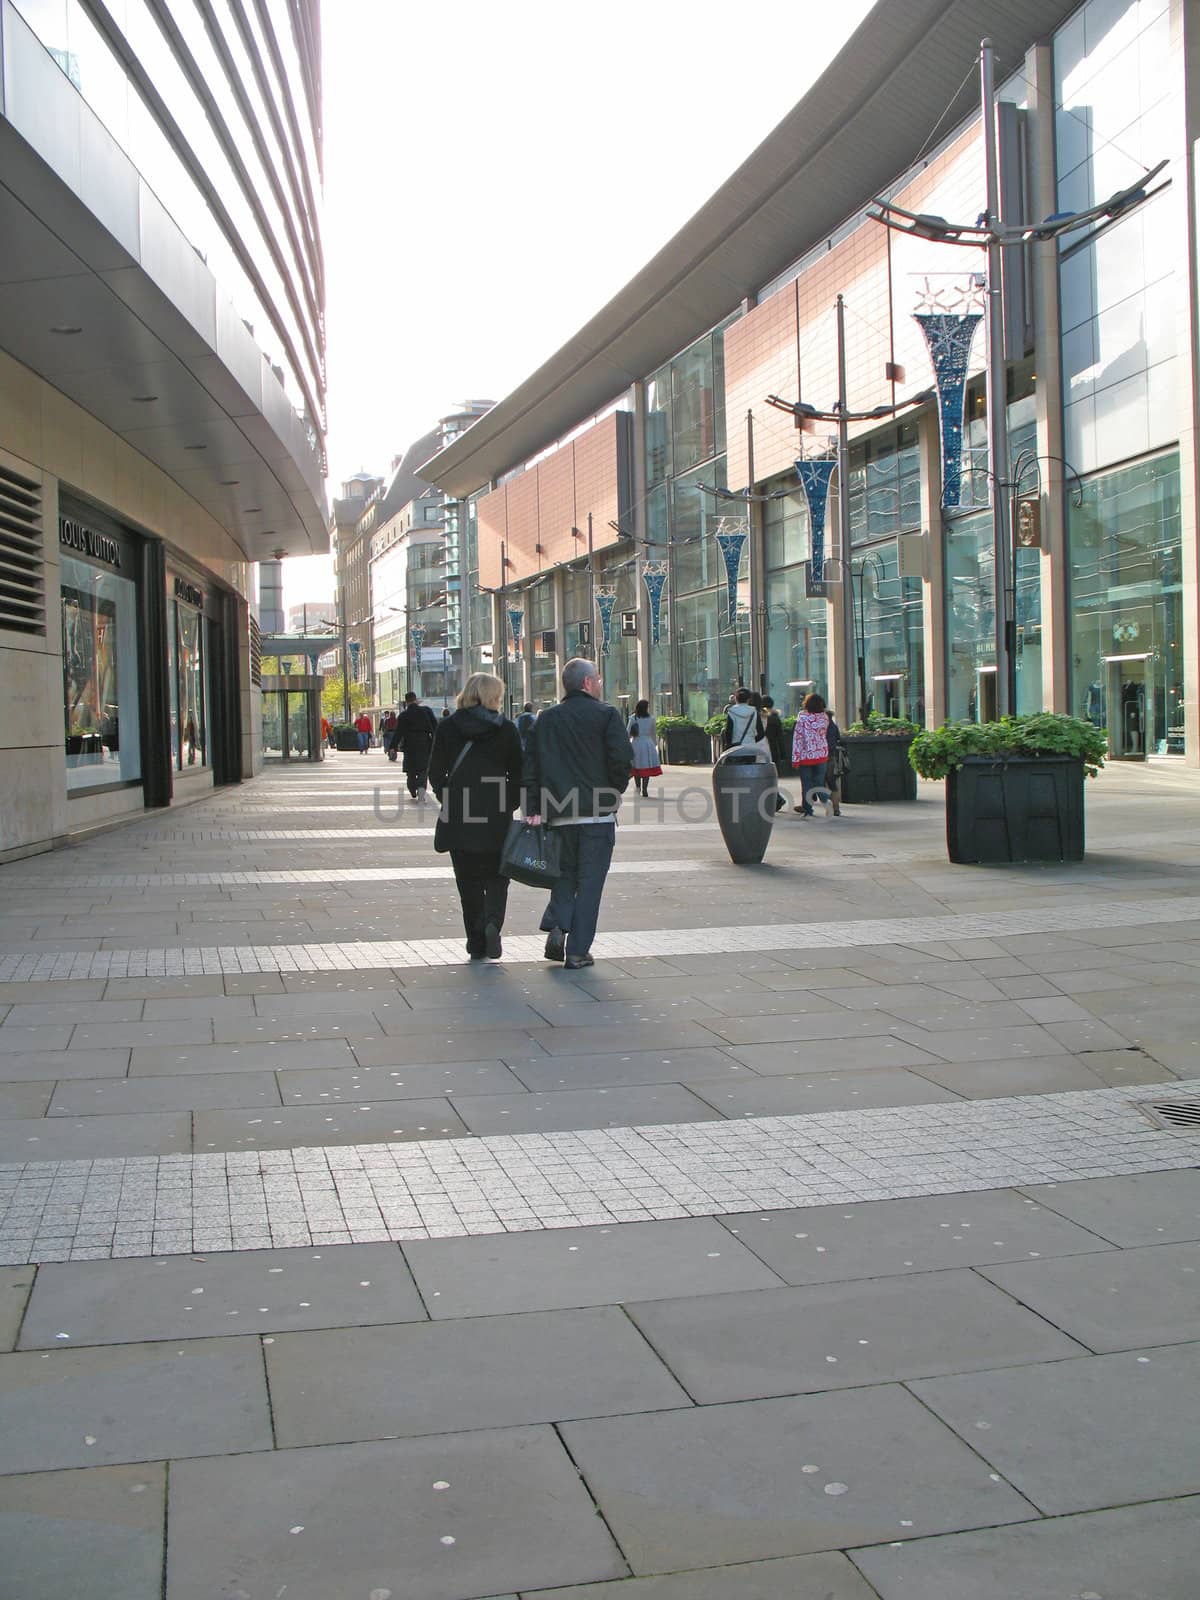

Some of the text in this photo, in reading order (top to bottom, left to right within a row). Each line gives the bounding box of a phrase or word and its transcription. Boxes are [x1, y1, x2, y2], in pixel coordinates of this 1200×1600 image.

[60, 519, 121, 567] LOUIS VUITTON
[622, 614, 636, 630] H
